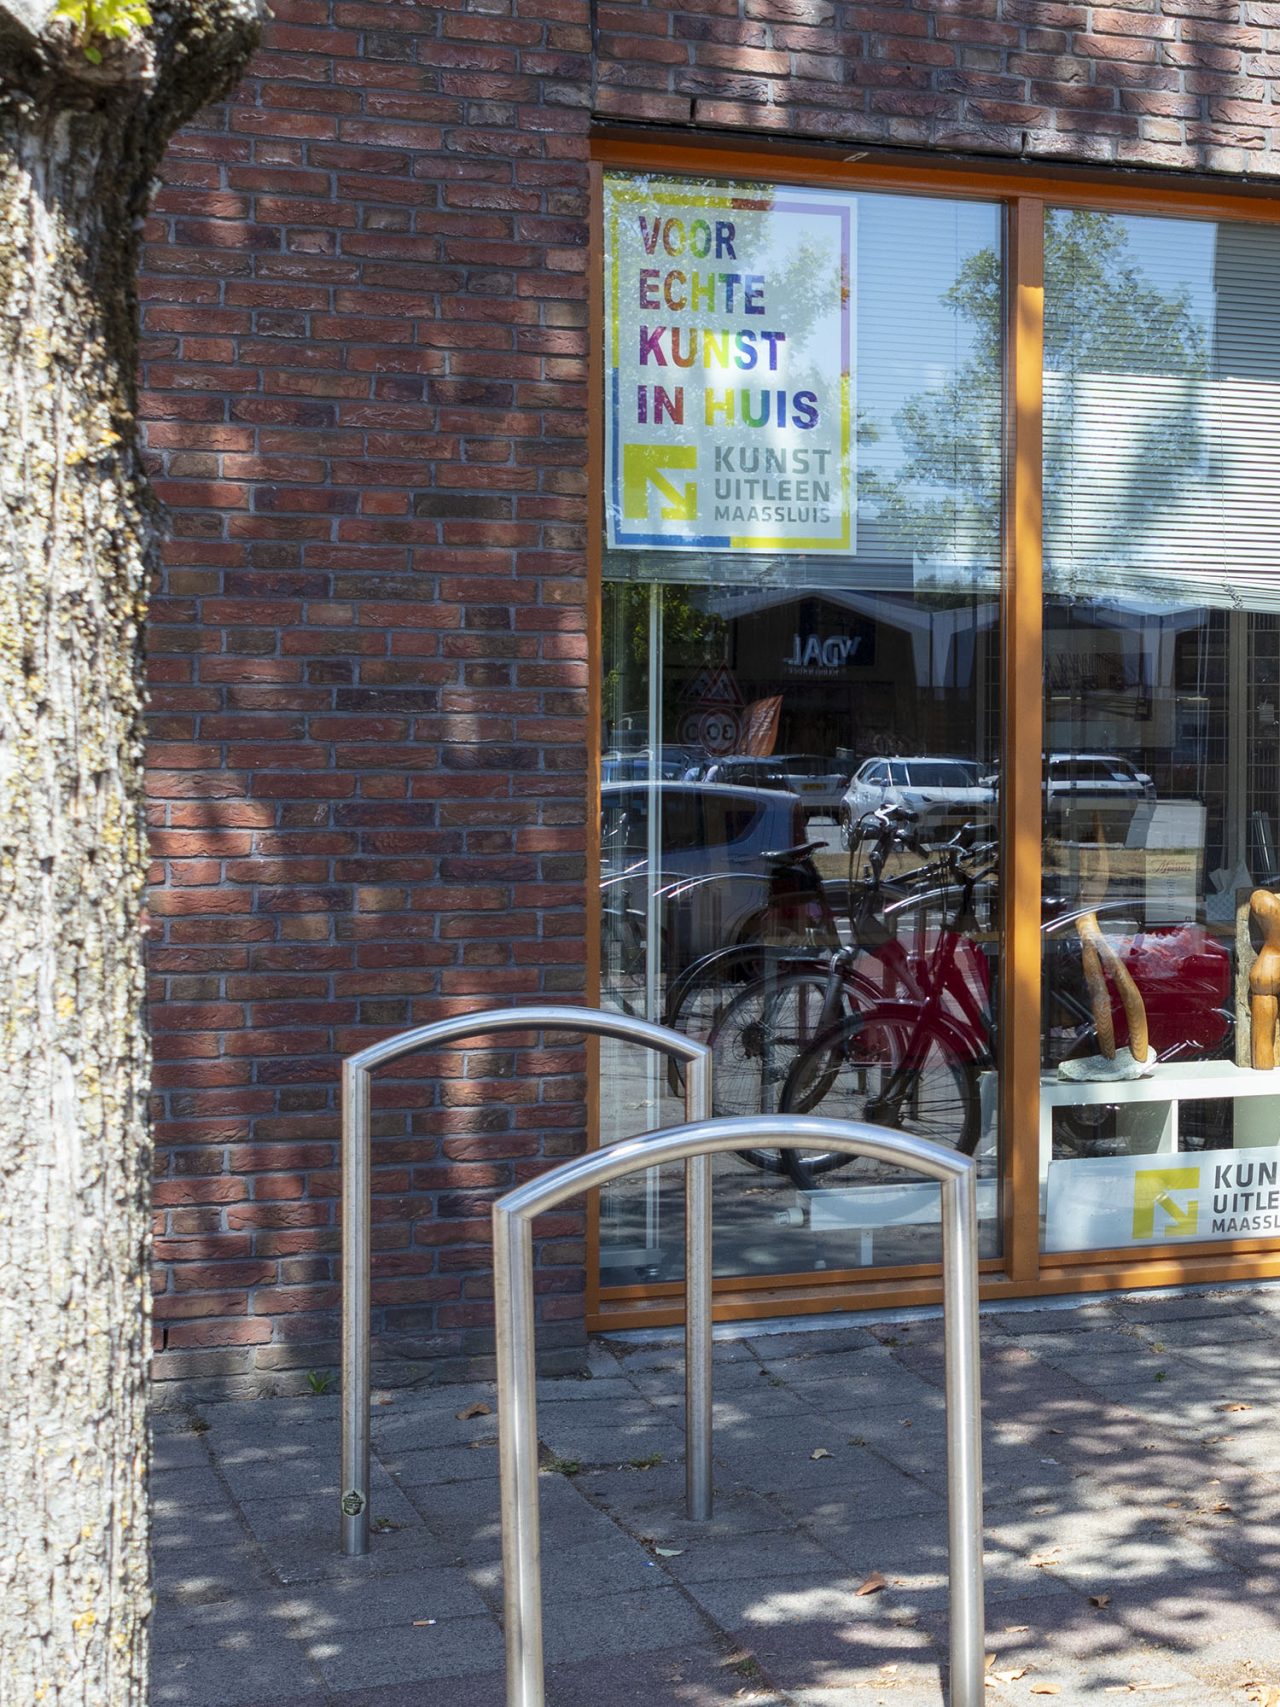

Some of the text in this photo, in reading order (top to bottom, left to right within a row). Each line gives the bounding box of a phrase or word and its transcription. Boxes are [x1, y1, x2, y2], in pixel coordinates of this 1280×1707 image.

[638, 215, 736, 260] VOOR
[638, 267, 766, 315] ECHTE
[638, 325, 786, 371] KUNST
[637, 384, 820, 430] IN HUIS
[714, 445, 832, 475] KUNST
[714, 477, 831, 502] UITLEEN
[713, 506, 831, 524] MAASSLUIS
